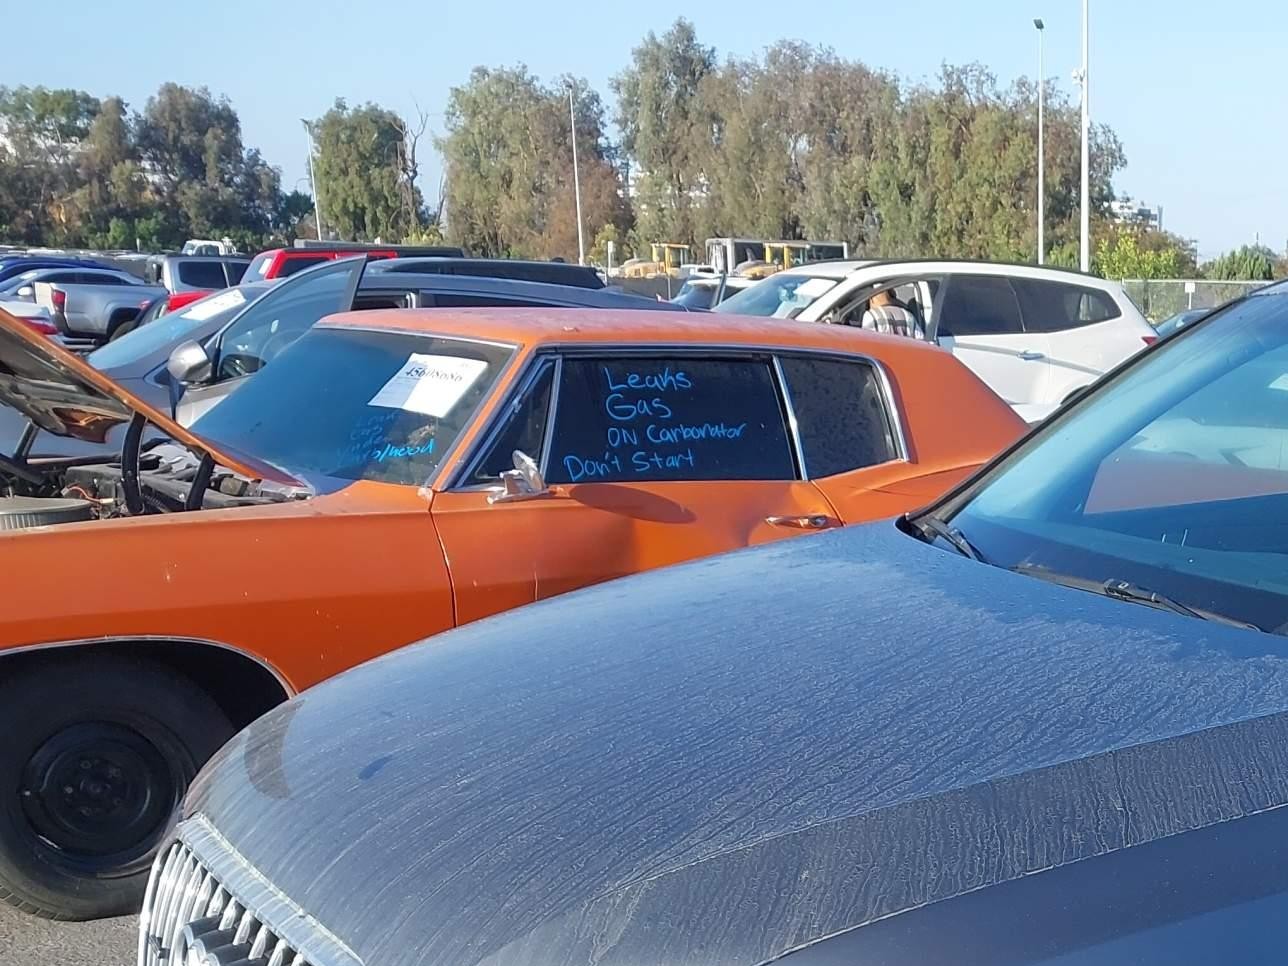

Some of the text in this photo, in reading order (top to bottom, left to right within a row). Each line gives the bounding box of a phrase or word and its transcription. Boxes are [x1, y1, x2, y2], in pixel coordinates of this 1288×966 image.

[605, 393, 672, 420] Gas
[563, 448, 694, 481] Don't Start
